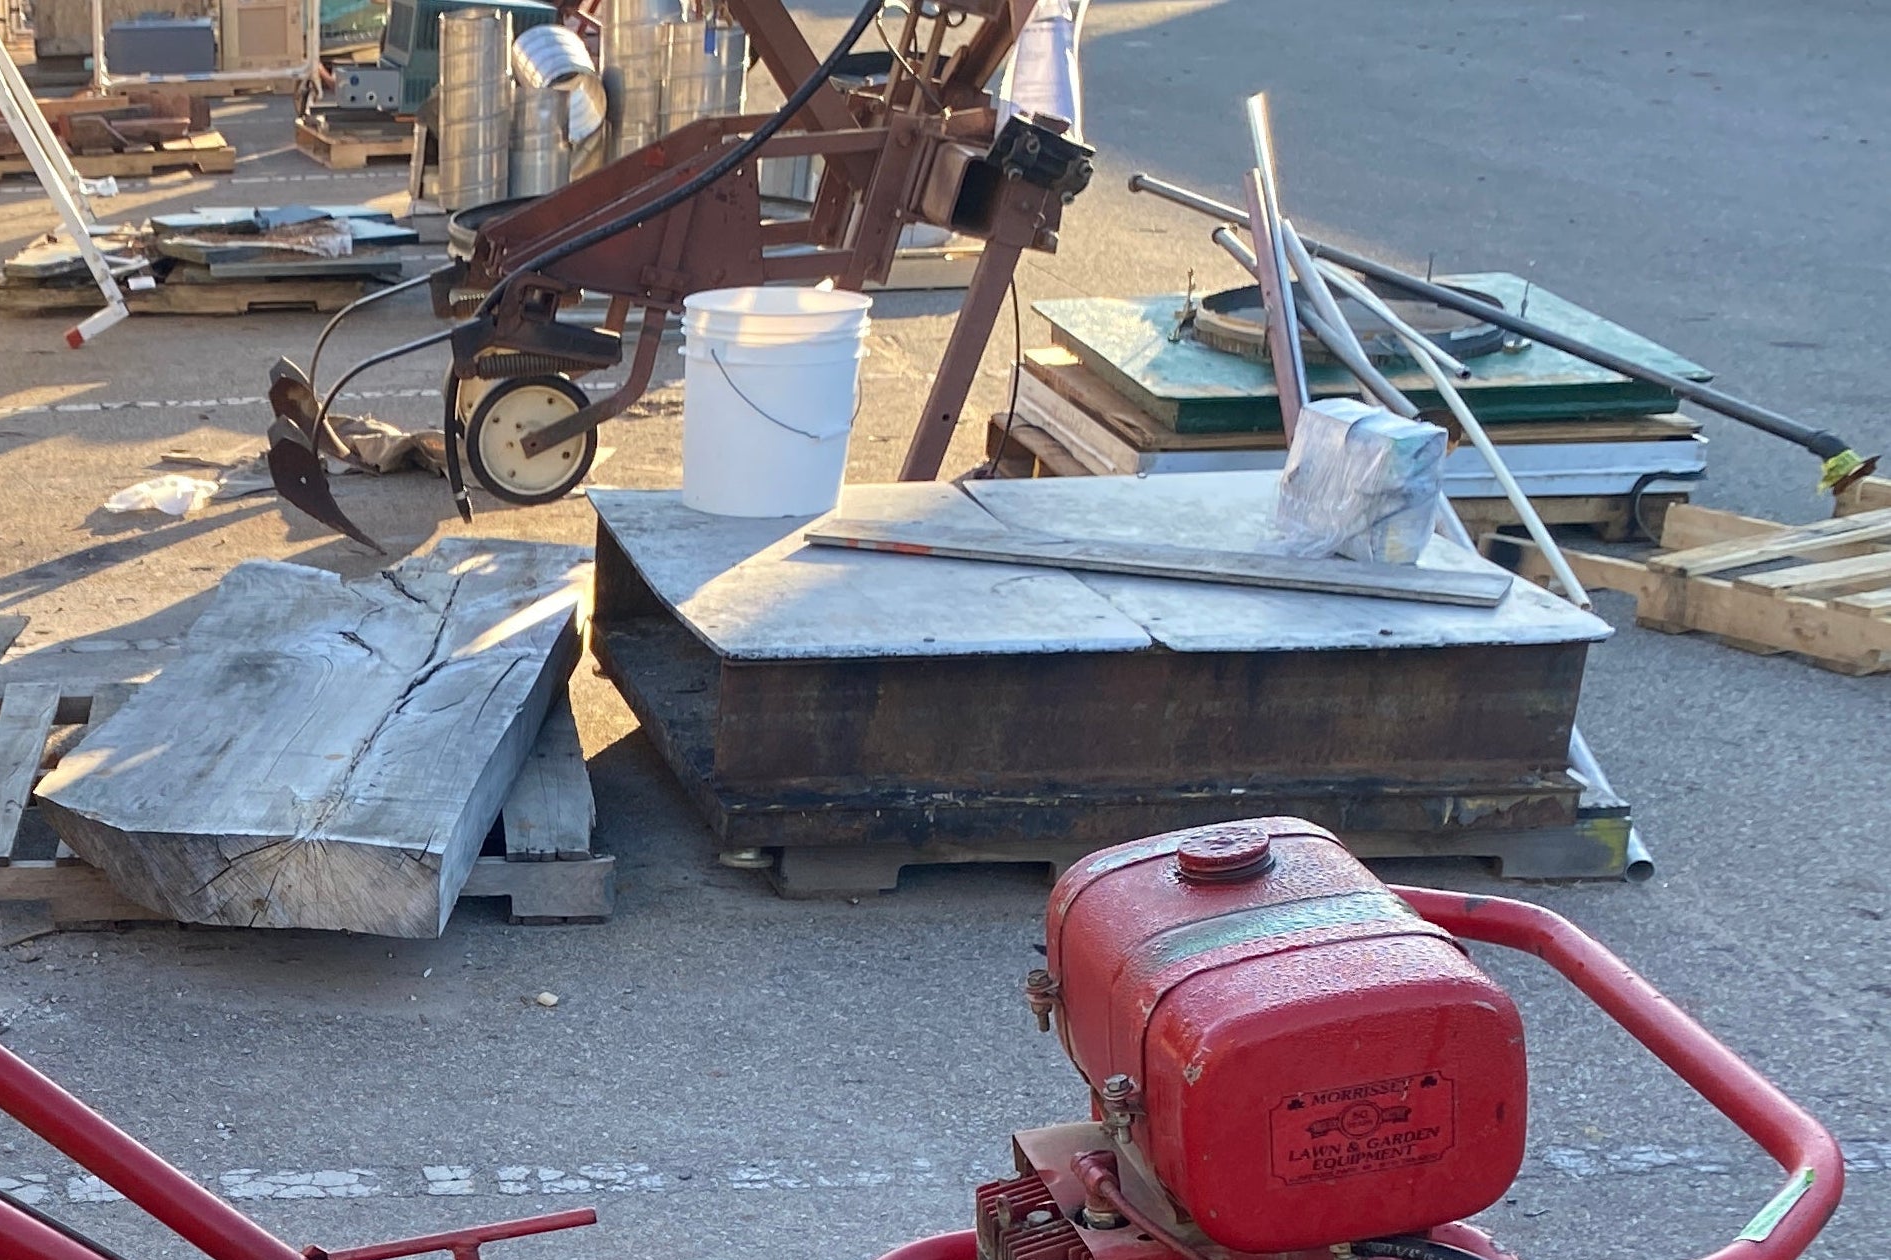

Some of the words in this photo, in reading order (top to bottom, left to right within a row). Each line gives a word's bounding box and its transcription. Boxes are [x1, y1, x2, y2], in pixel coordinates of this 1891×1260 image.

[1289, 1143, 1342, 1162] LAWN
[1347, 1140, 1359, 1153] &
[1367, 1126, 1440, 1150] GARDEN
[1312, 1143, 1416, 1171] EQUIPMENT
